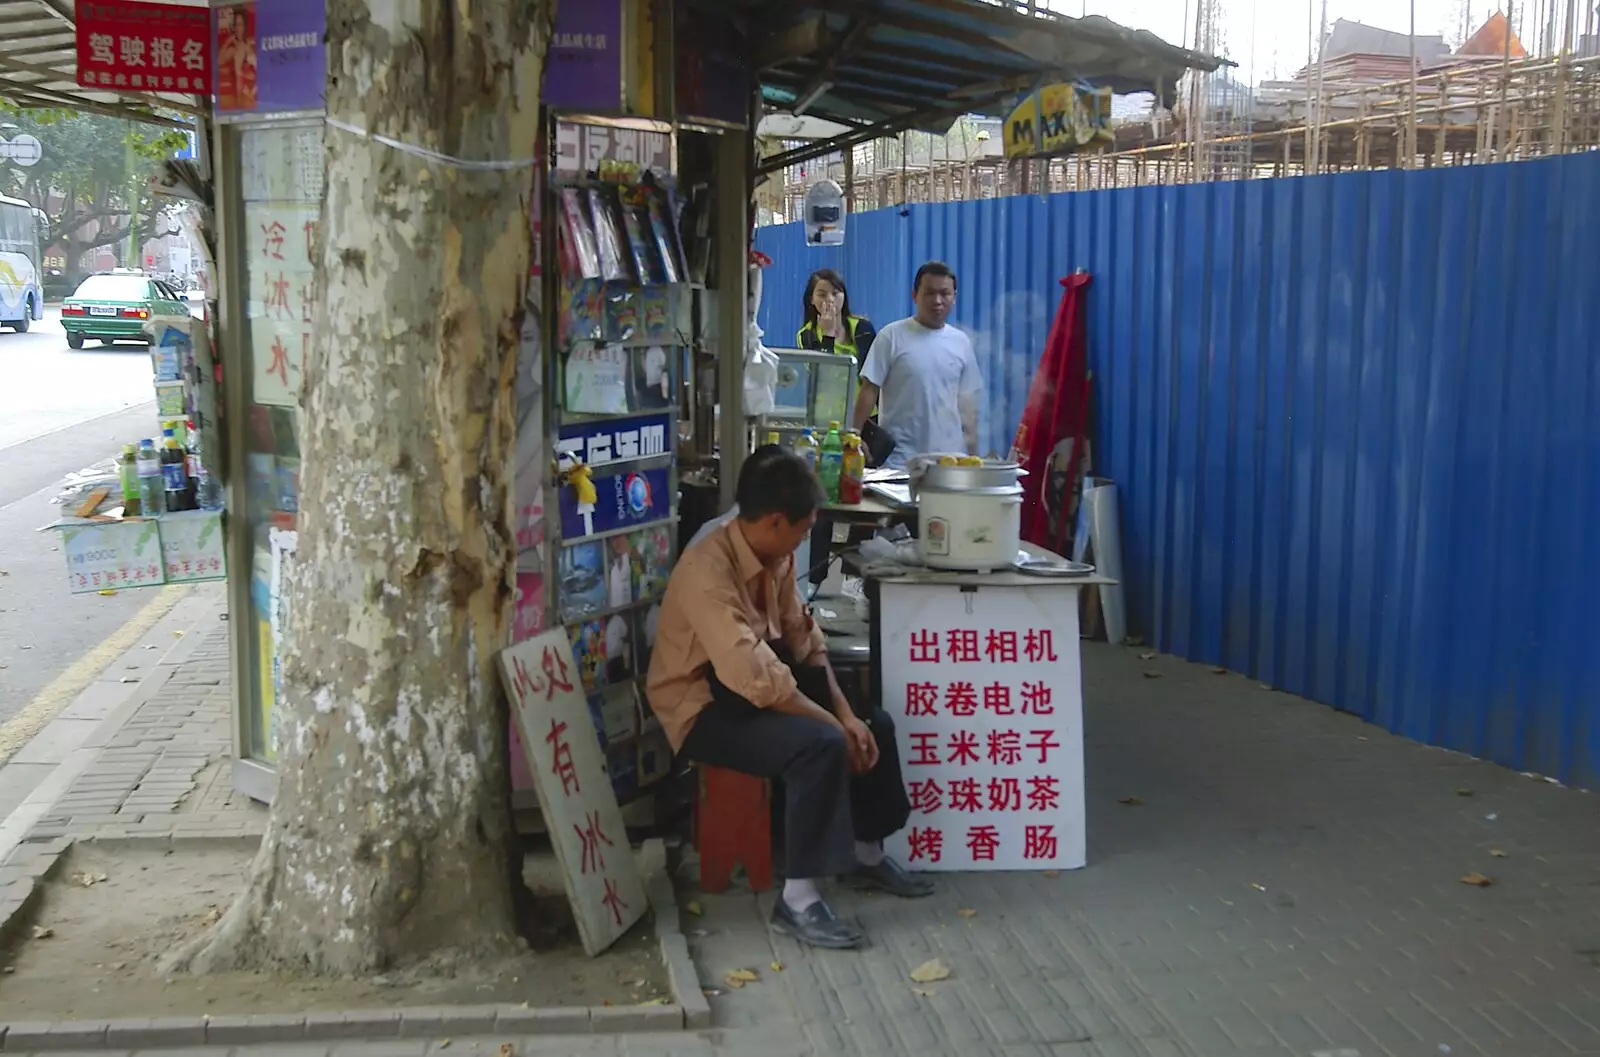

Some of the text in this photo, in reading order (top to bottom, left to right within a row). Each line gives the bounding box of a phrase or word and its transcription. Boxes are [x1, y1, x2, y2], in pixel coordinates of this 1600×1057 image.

[89, 32, 204, 70] 驾驶报名
[909, 628, 1058, 664] 出租相机
[904, 681, 1055, 717] 胶卷电池
[907, 729, 1060, 766] 玉米粽子
[908, 775, 1060, 815] 珍珠奶茶
[907, 824, 1057, 863] 烤香肠
